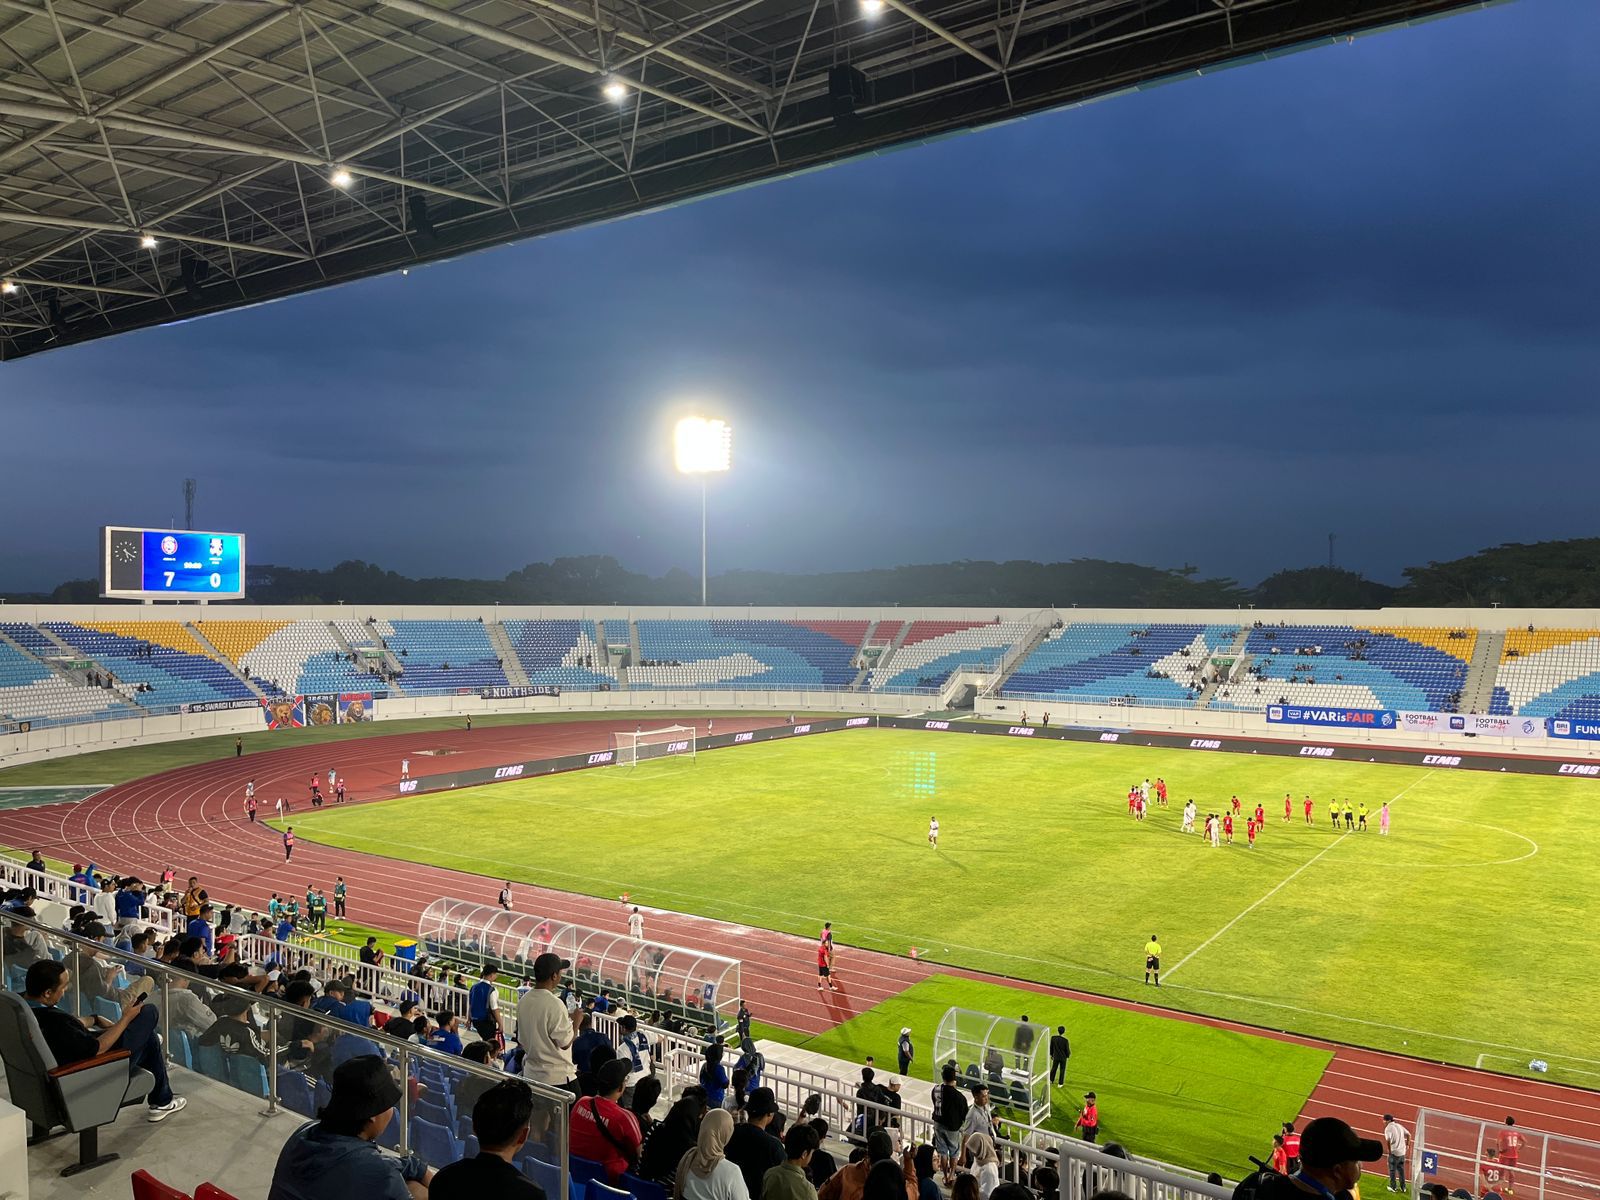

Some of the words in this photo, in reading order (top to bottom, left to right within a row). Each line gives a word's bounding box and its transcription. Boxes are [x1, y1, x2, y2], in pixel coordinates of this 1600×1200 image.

[163, 571, 176, 587] 7
[210, 572, 221, 588] 0
[493, 686, 551, 697] NORTHSIDE
[1303, 710, 1375, 723] #VARisFAIR
[1405, 713, 1438, 721] FOOTBALL
[1190, 739, 1222, 749] ETMS
[1300, 746, 1335, 757] ETMS
[1422, 754, 1461, 766] ETMS
[494, 764, 524, 778] ETMS
[1487, 1169, 1499, 1182] 26
